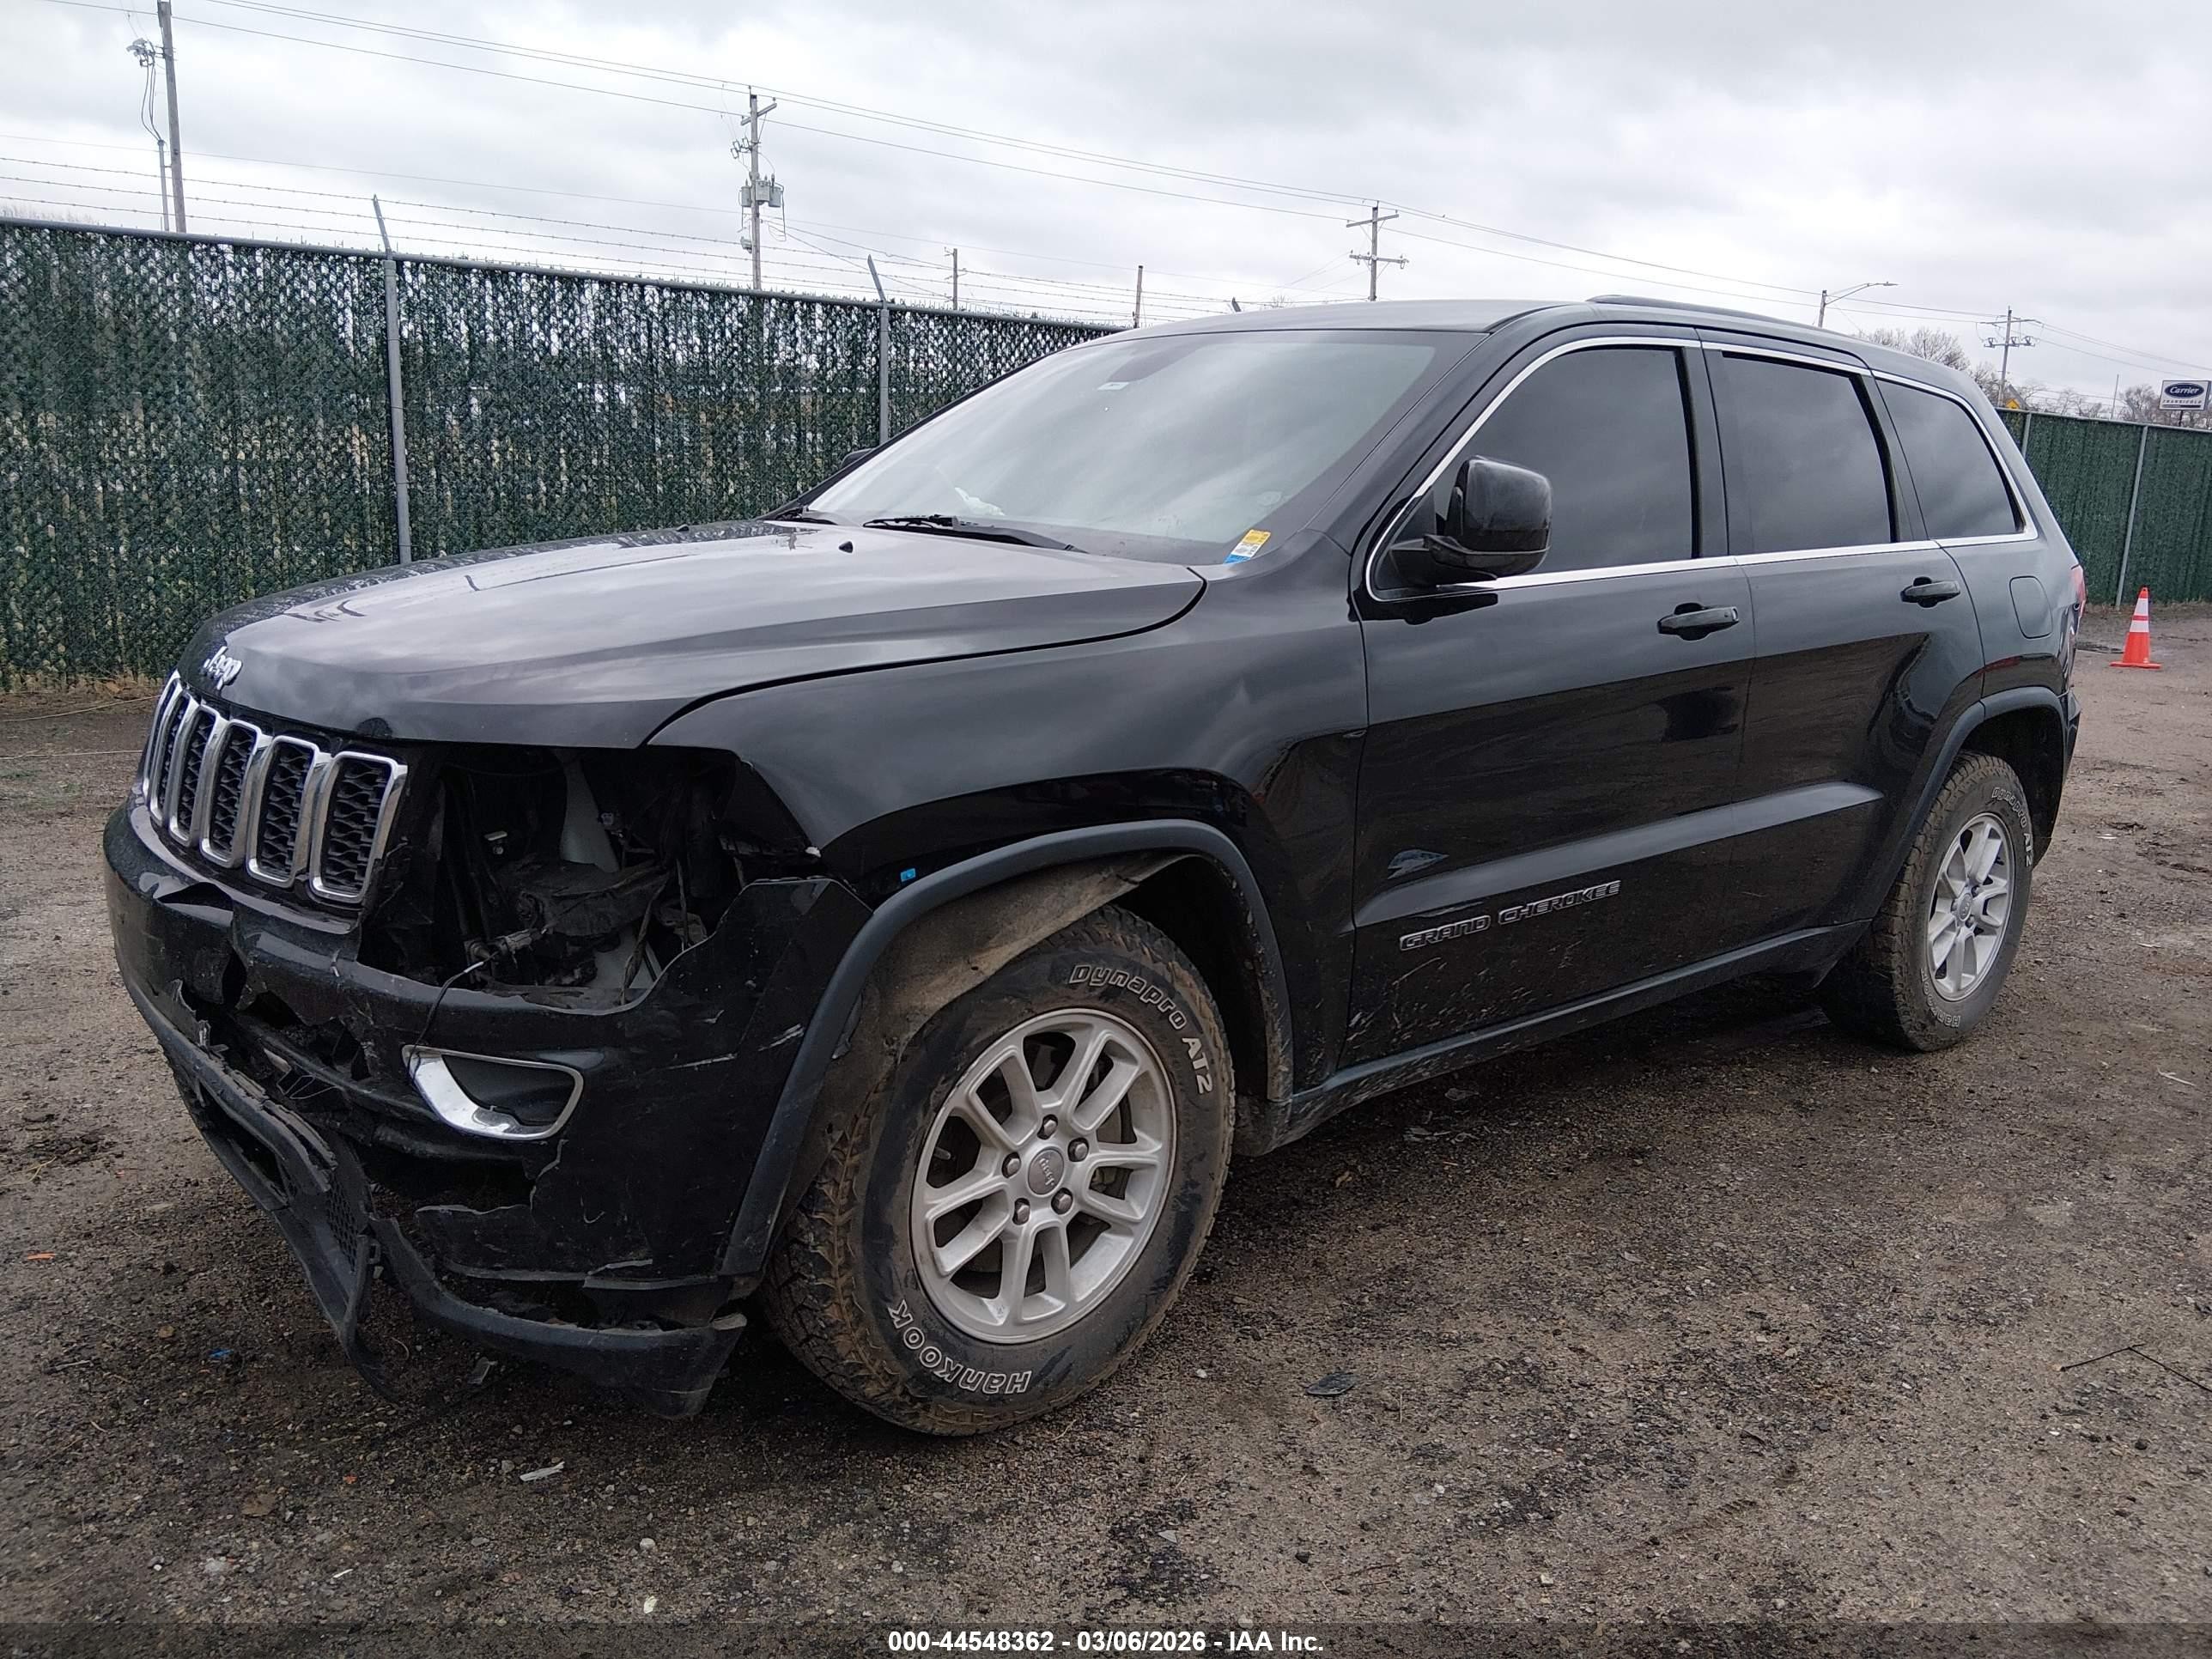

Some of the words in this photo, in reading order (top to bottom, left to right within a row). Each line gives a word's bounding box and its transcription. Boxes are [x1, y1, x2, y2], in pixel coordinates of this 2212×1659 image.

[203, 645, 243, 690] Jeep
[1400, 915, 1492, 951] GRAND
[1498, 880, 1622, 925] CHEROKEE
[1182, 1036, 1213, 1095] AT2
